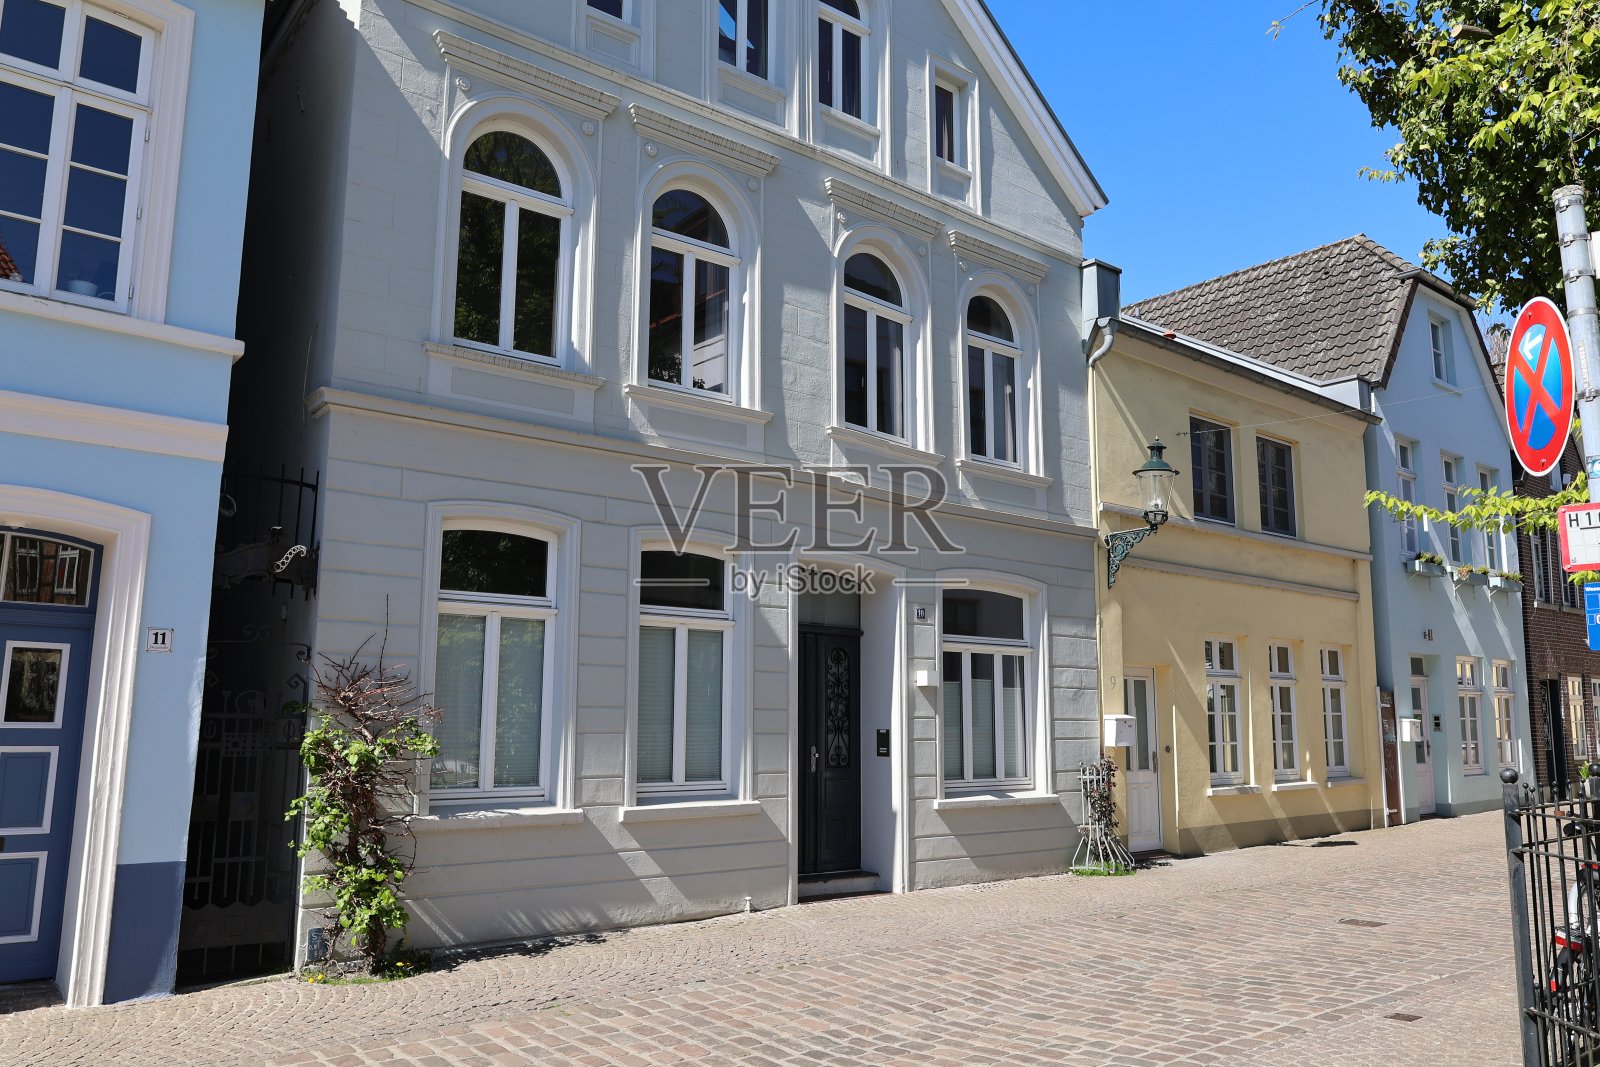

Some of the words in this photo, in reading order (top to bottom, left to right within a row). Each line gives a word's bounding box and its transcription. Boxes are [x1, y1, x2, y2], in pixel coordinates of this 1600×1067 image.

[918, 609, 925, 618] 10
[152, 631, 167, 645] 11
[1110, 676, 1116, 690] 9
